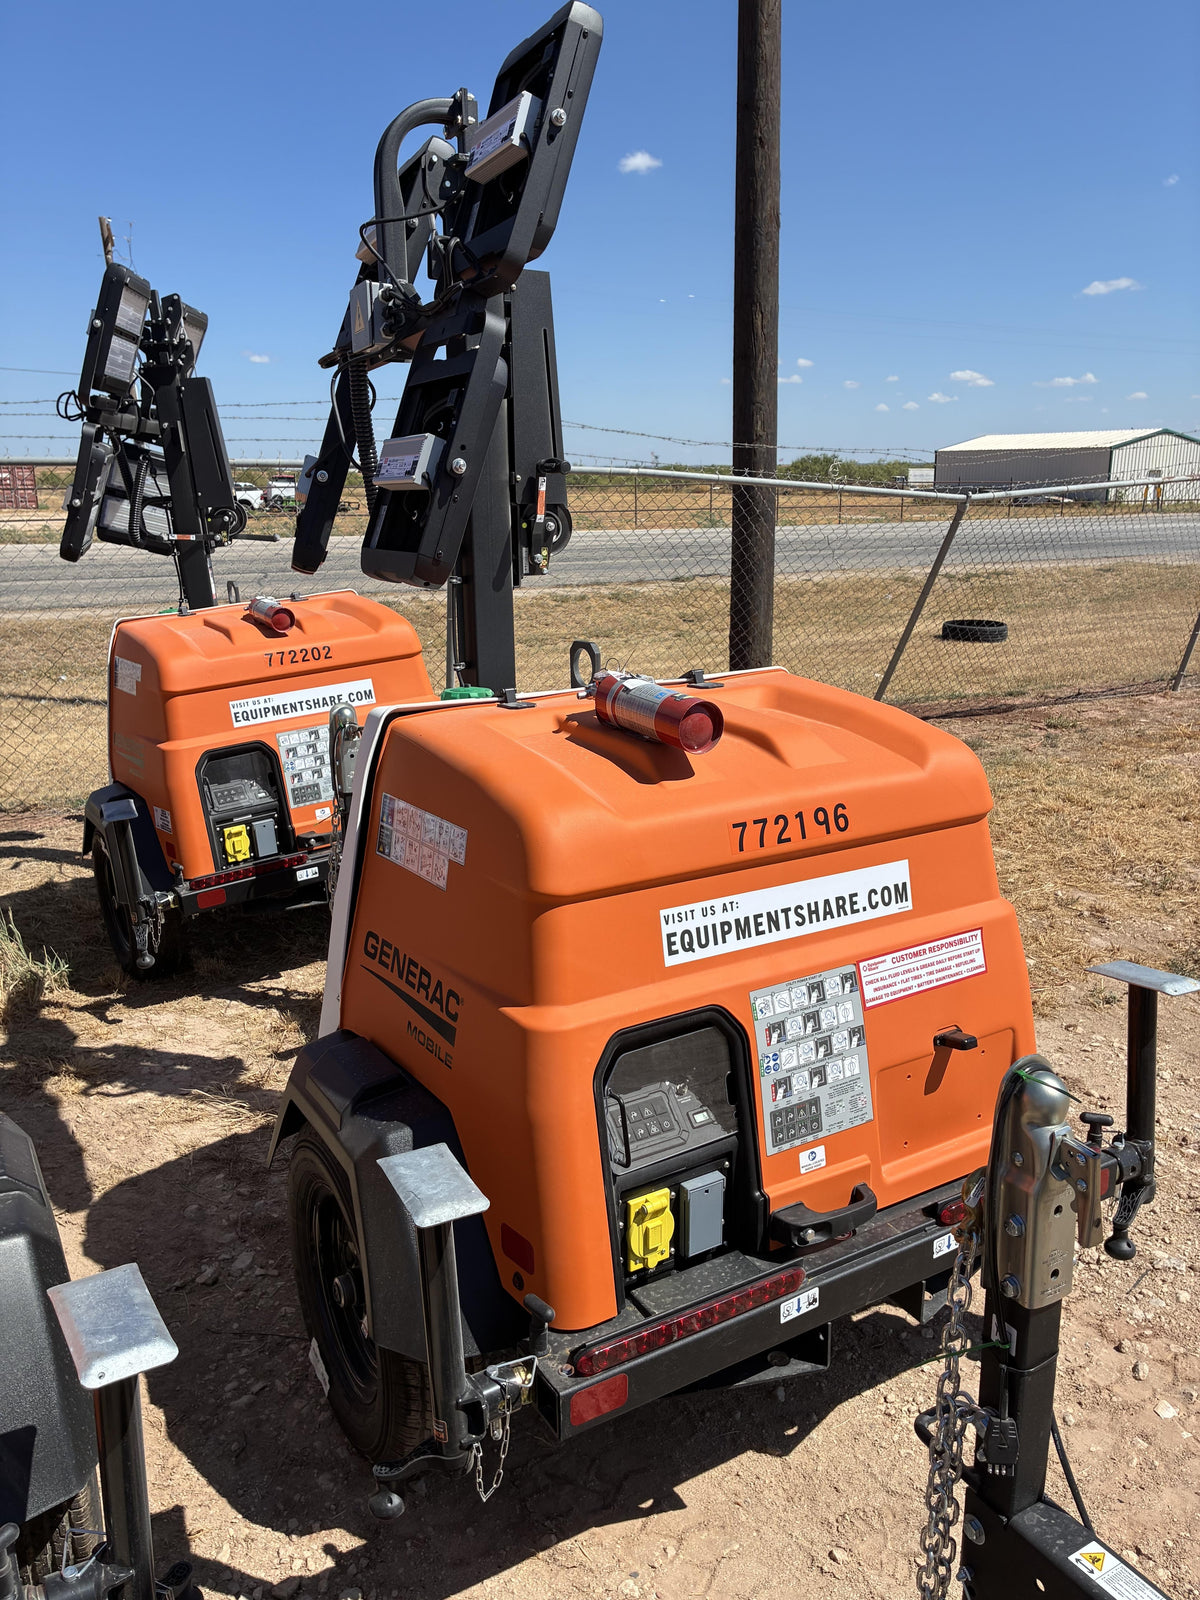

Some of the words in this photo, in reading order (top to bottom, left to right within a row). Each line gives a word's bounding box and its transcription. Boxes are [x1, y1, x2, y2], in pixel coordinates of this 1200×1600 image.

[264, 645, 333, 667] 772202
[231, 701, 250, 709] VISIT
[732, 803, 850, 852] 772196
[663, 909, 696, 926] VISIT
[701, 905, 716, 918] US
[722, 901, 739, 914] AT:
[665, 881, 909, 957] EQUIPMENTSHARE.COM
[865, 977, 880, 986] CHECK
[888, 971, 900, 979] FLUID
[901, 967, 915, 975] LEVELS
[920, 961, 935, 970] GREASE
[936, 958, 947, 966] DAILY
[948, 953, 962, 962] BEFORE
[963, 949, 974, 957] START
[891, 949, 927, 965] CUSTOMER
[928, 933, 978, 954] RESPONSIBILITY
[363, 930, 460, 1023] GENERAC
[866, 995, 883, 1003] DAMAGE
[890, 985, 914, 996] EQUIPMENT
[917, 979, 934, 988] BATTERY
[935, 970, 963, 982] MAINTENANCE
[966, 964, 985, 973] CLEANING
[873, 981, 897, 992] INSURANCE
[935, 965, 952, 974] DAMAGE
[955, 958, 976, 968] REFUELING
[406, 1020, 453, 1070] MOBILE
